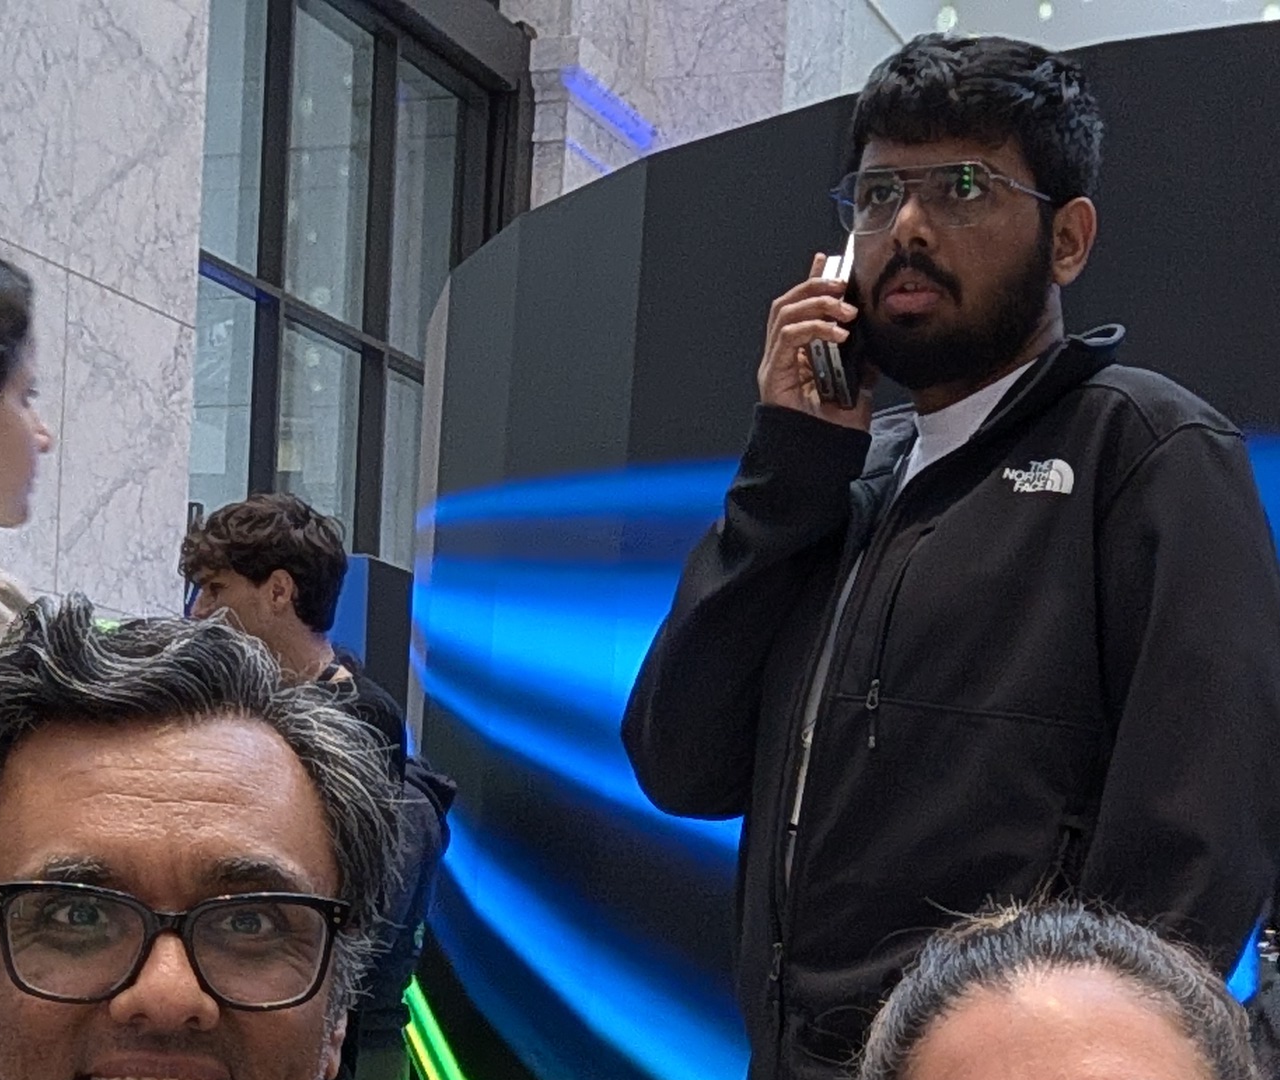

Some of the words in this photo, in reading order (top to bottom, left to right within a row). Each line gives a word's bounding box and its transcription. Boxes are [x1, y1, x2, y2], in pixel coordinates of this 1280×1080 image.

[1029, 460, 1052, 473] THE
[1002, 467, 1048, 481] NORTH
[1013, 480, 1046, 492] FACE
